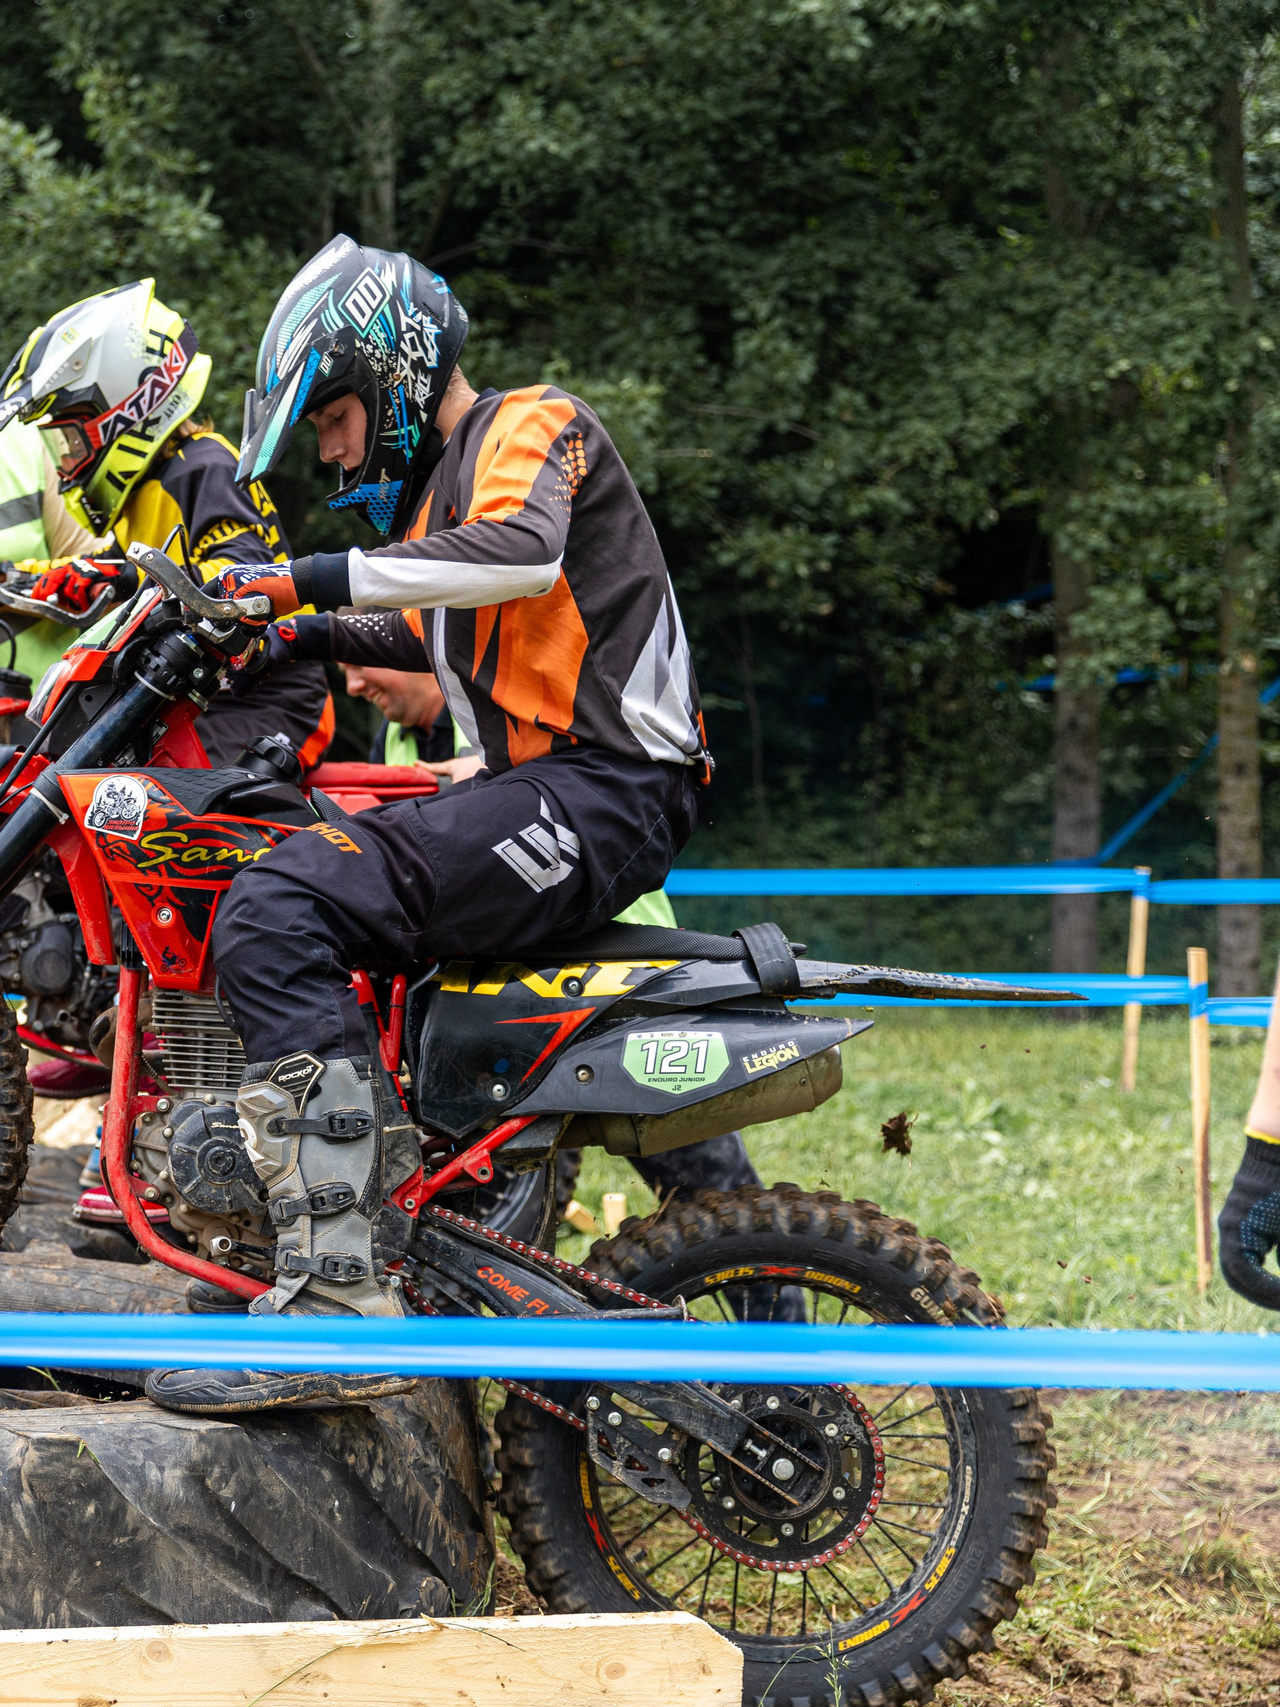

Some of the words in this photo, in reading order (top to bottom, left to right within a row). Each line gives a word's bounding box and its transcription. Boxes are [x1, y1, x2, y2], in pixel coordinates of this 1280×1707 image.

[98, 341, 188, 446] ATAKI
[641, 1039, 710, 1075] 121
[742, 1040, 795, 1062] ENDURO
[743, 1045, 801, 1074] LEGION
[704, 1266, 755, 1286] SERIES
[758, 1265, 805, 1277] X
[804, 1270, 861, 1294] ENDURO
[477, 1266, 530, 1302] COME
[526, 1298, 560, 1315] FL
[585, 1510, 610, 1555] X
[606, 1555, 642, 1600] SERIES
[838, 1620, 891, 1651] ENDURO
[890, 1590, 928, 1627] X
[924, 1546, 957, 1593] SERIES
